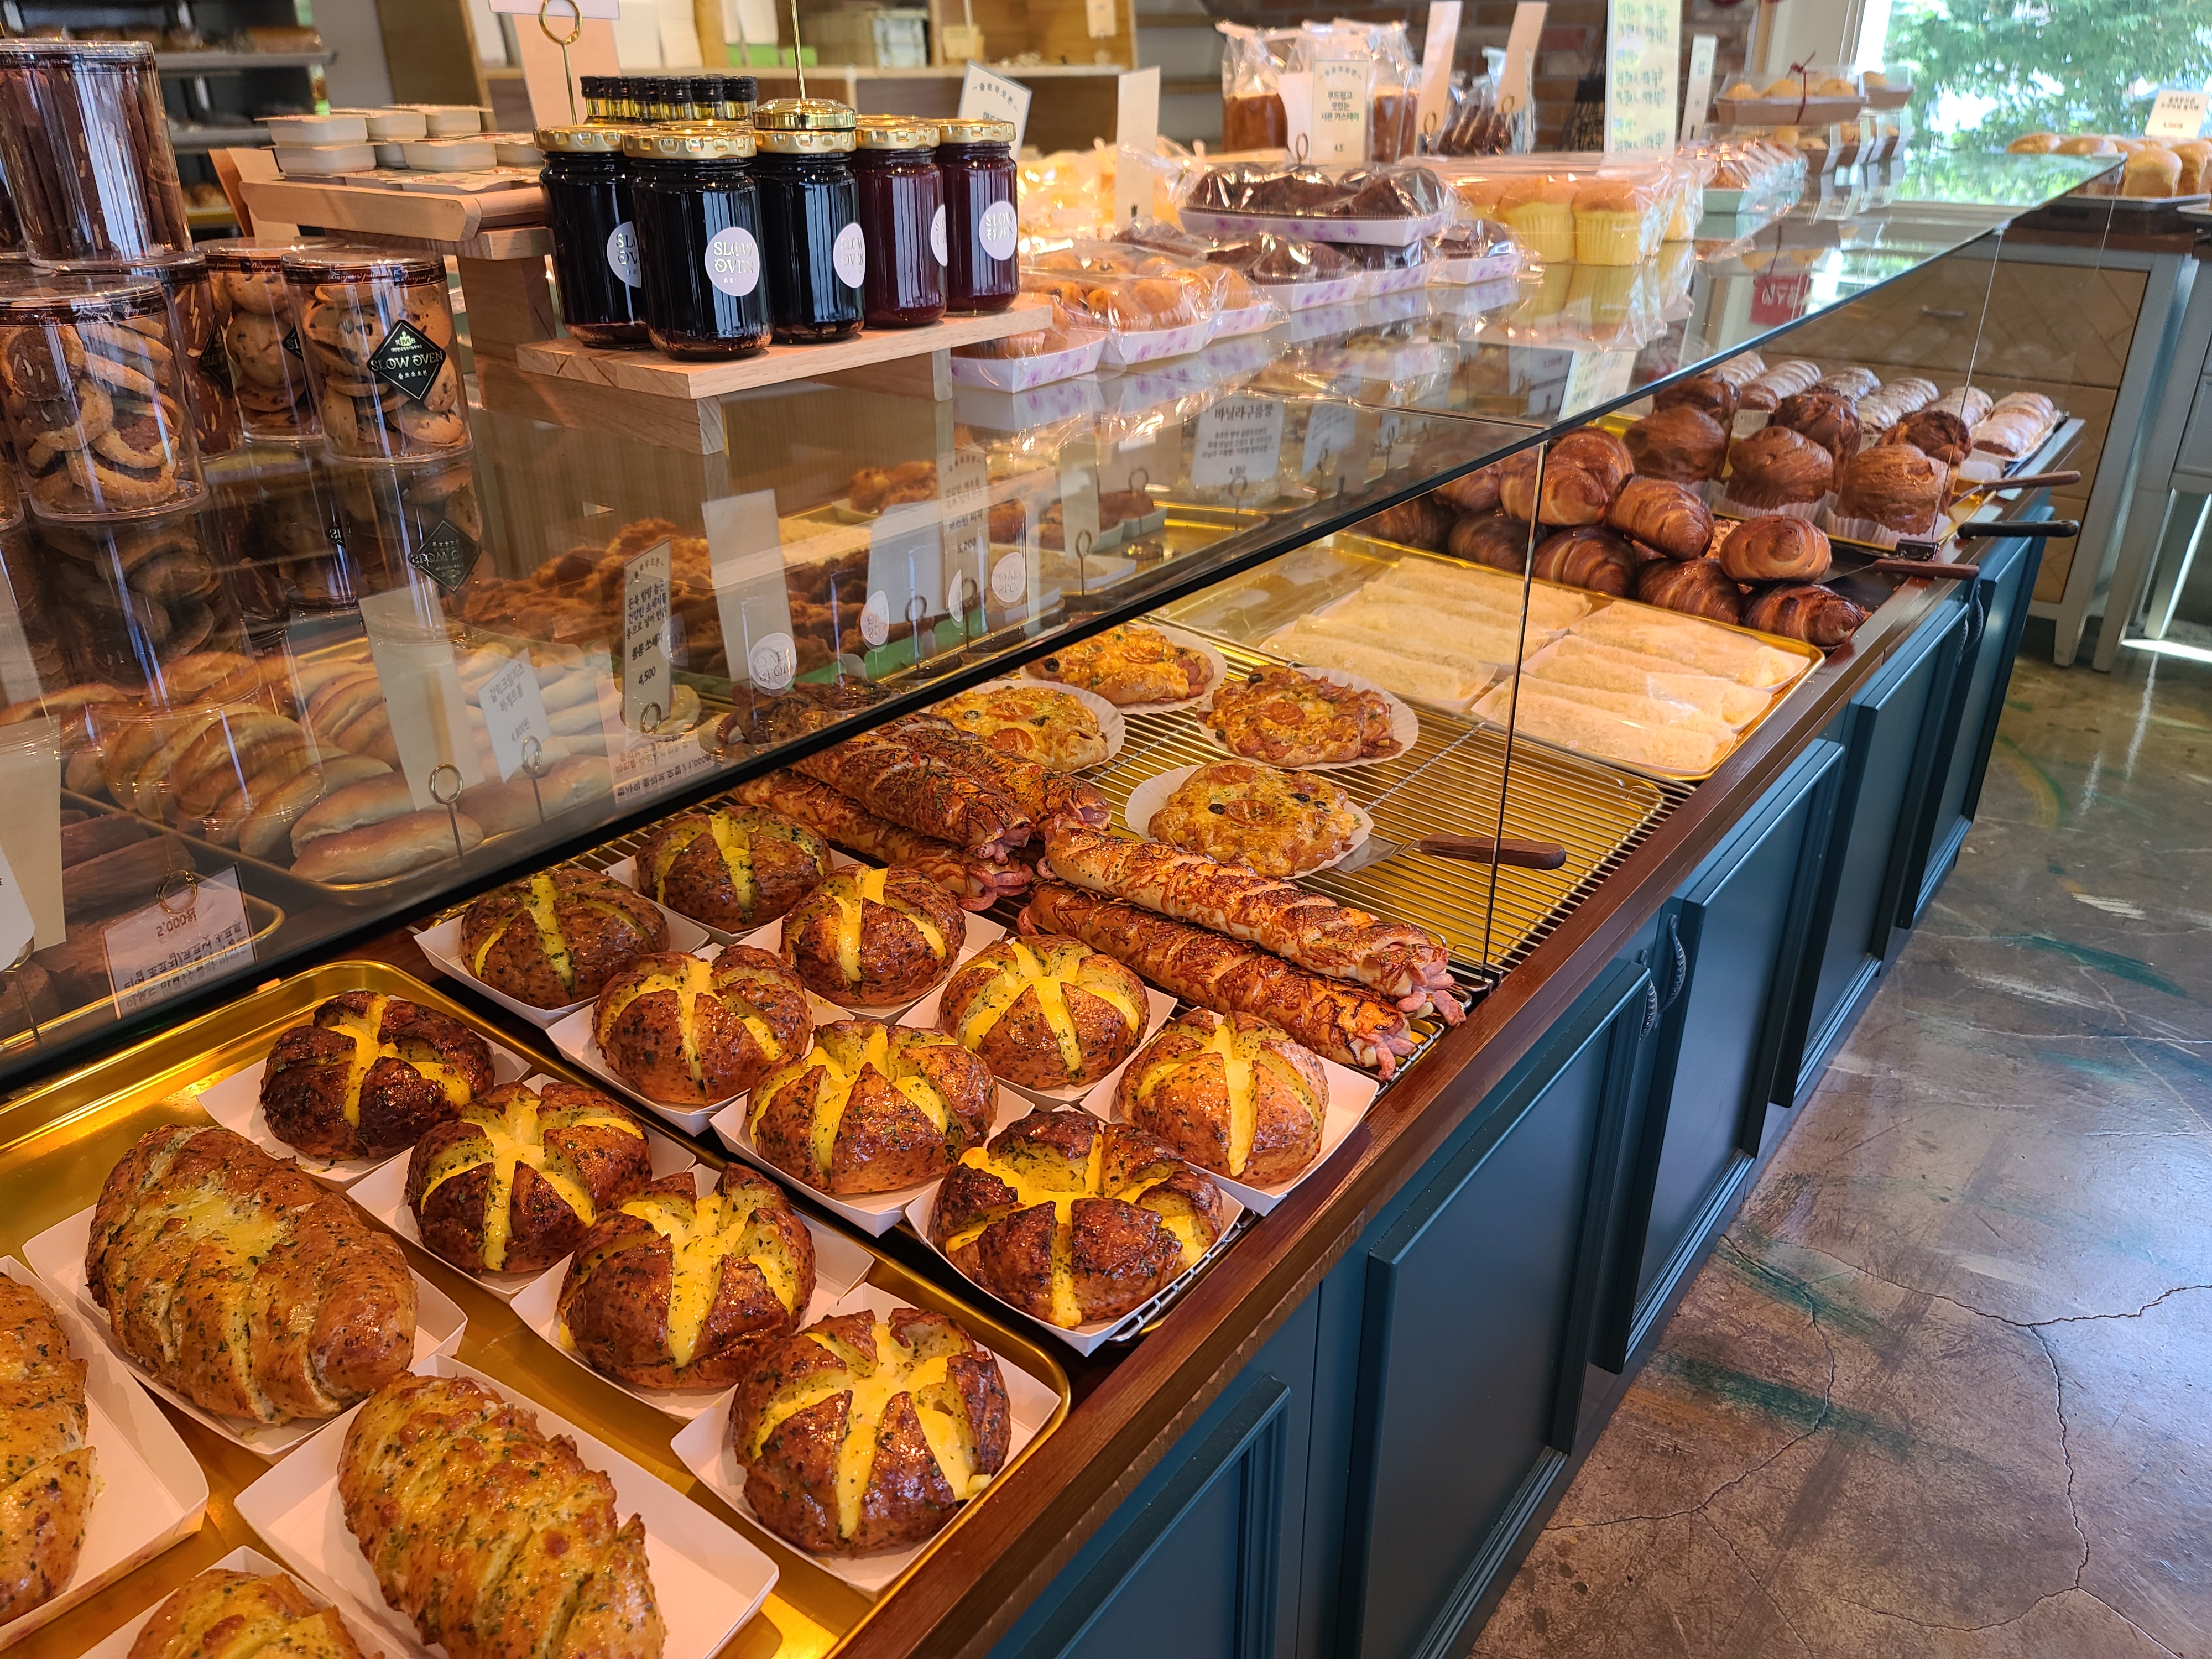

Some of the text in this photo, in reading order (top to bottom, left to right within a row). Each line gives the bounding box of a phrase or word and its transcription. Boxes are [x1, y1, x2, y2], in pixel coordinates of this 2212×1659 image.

[986, 212, 1013, 226] SLOW
[713, 241, 754, 257] SLOW
[714, 258, 755, 275] OVEN
[371, 350, 445, 372] SLOW OVEN
[971, 509, 983, 522] 피자
[957, 537, 977, 554] 5,200
[488, 662, 525, 703] 갈릭크림치즈
[639, 666, 657, 685] 4,500
